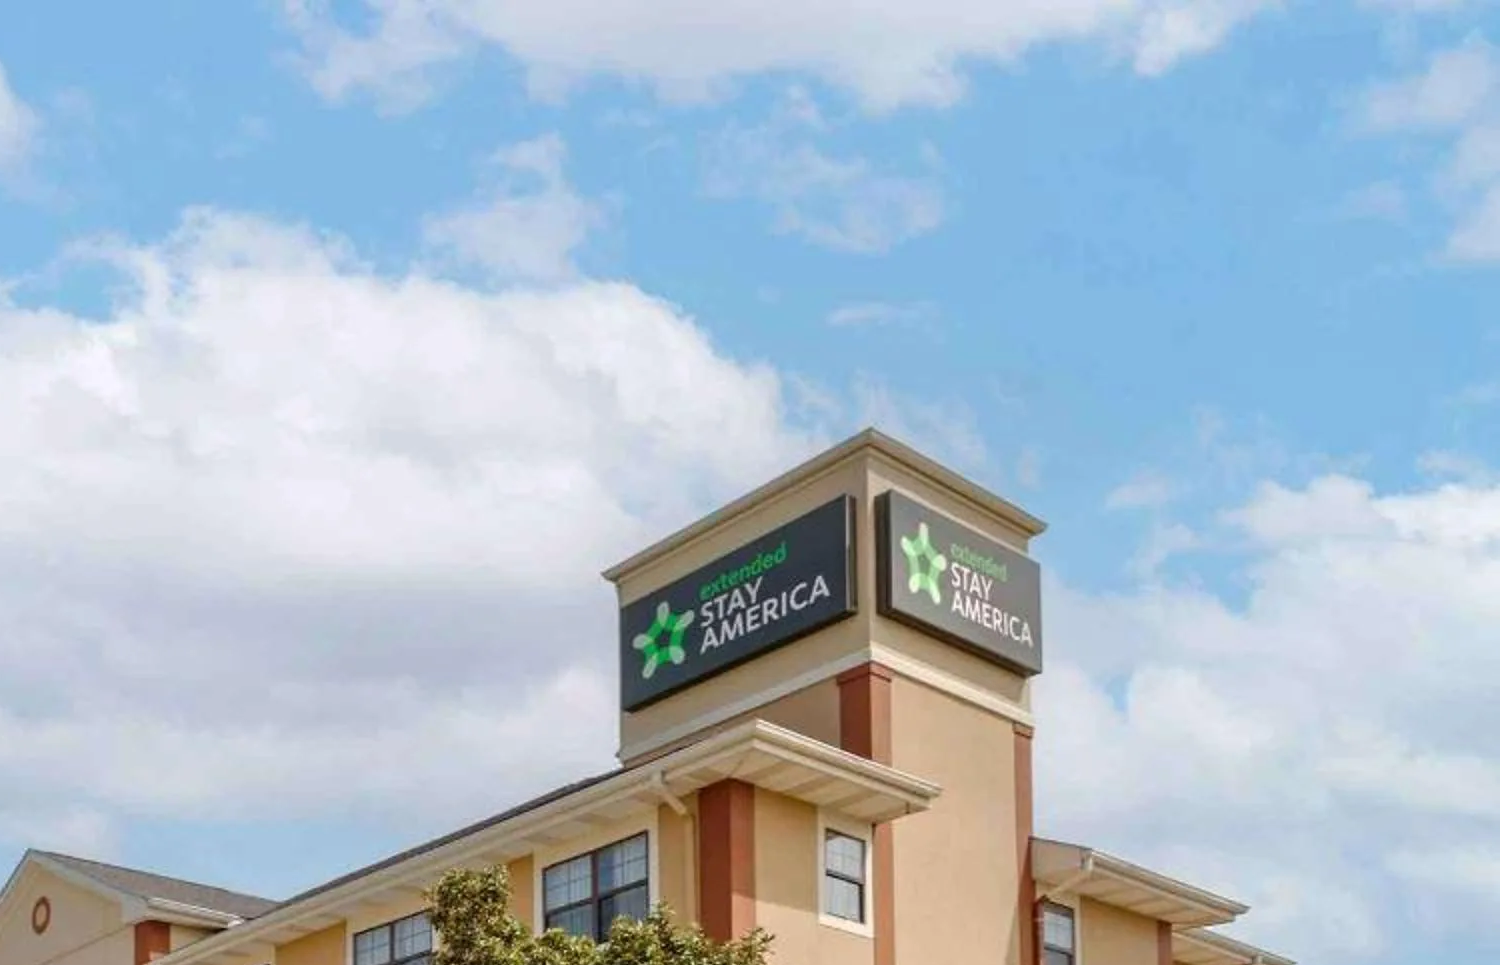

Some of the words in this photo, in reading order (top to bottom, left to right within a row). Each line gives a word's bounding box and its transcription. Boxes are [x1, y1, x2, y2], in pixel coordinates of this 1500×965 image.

[700, 541, 787, 599] extended
[950, 544, 1007, 582] extended
[951, 562, 993, 600] STAY
[700, 576, 763, 627] STAY
[700, 575, 830, 654] AMERICA
[951, 590, 1034, 648] AMERICA
